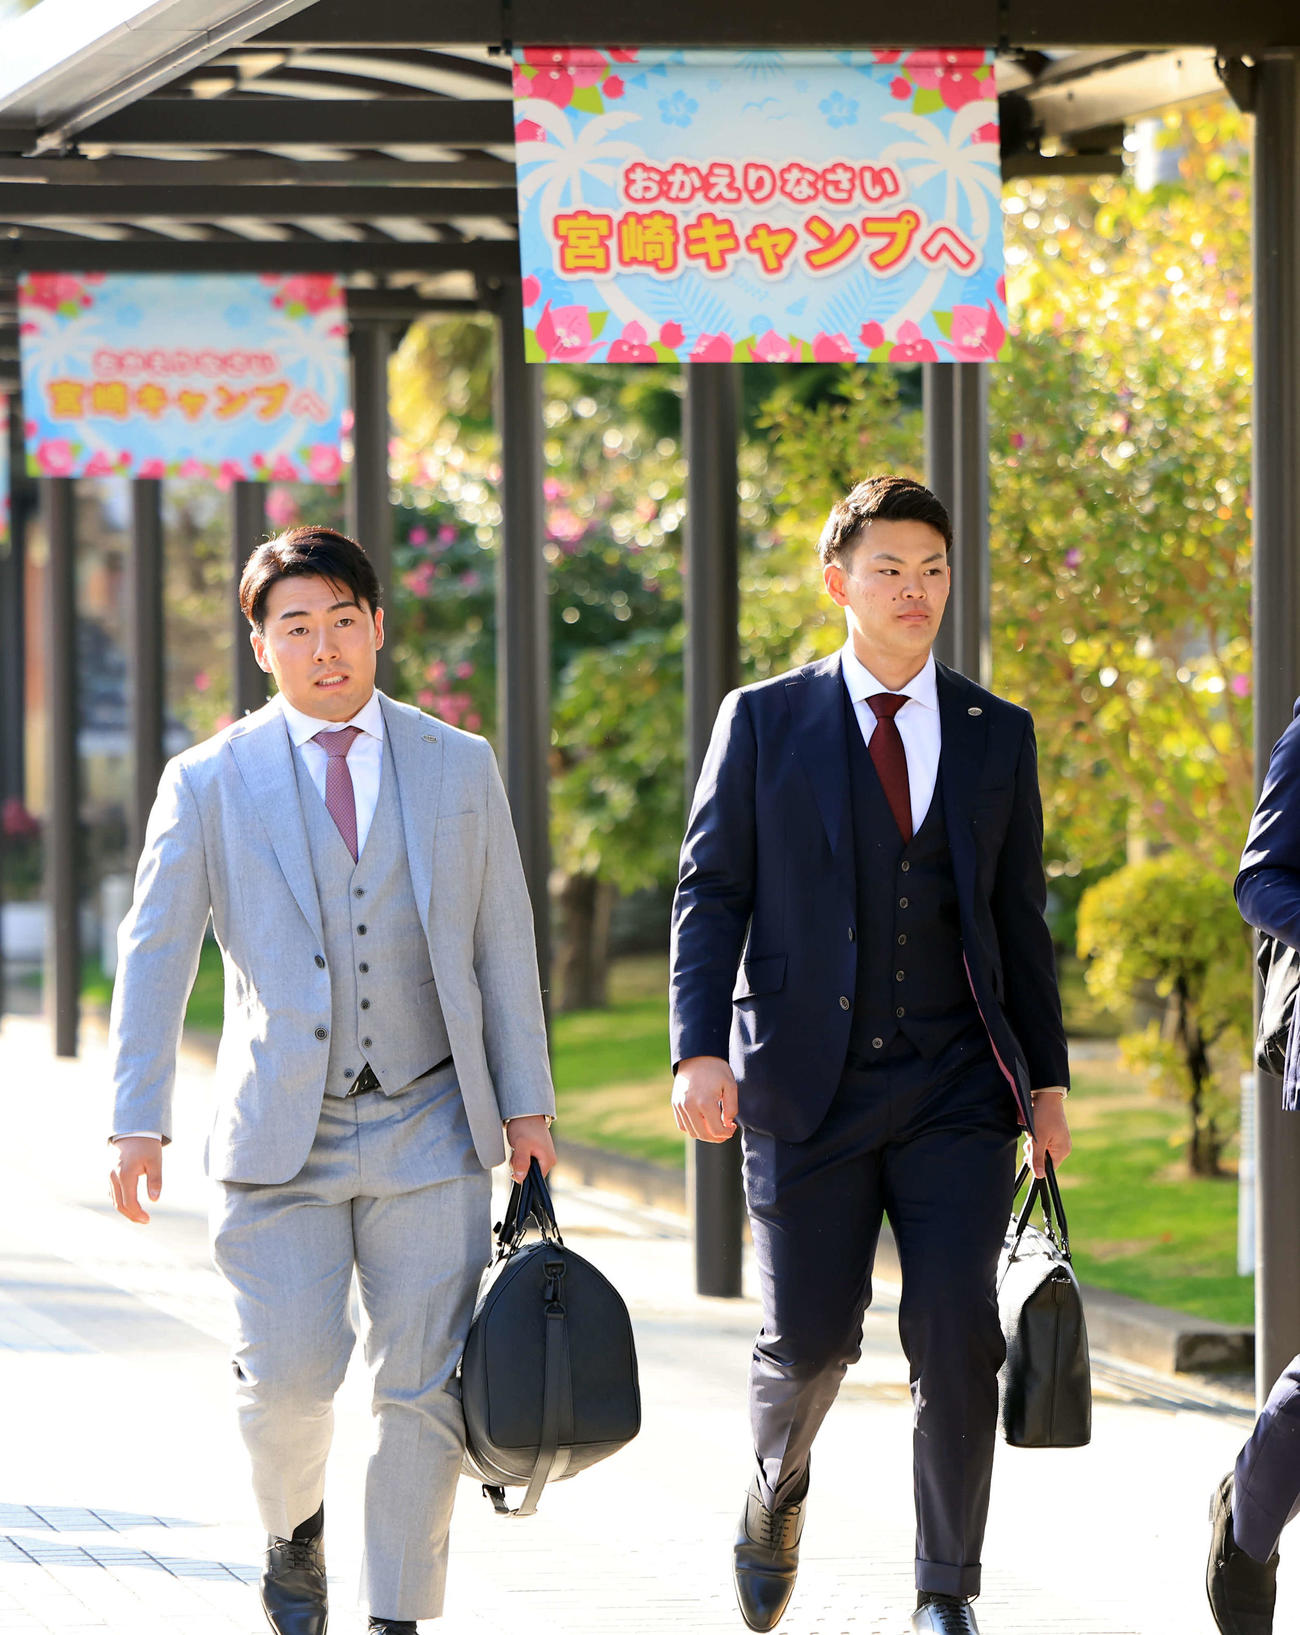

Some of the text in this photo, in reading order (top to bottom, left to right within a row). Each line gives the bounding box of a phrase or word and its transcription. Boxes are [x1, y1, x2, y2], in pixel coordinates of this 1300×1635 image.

[624, 161, 900, 204] おかえりなさい
[554, 209, 975, 275] 宮崎キャンプへ
